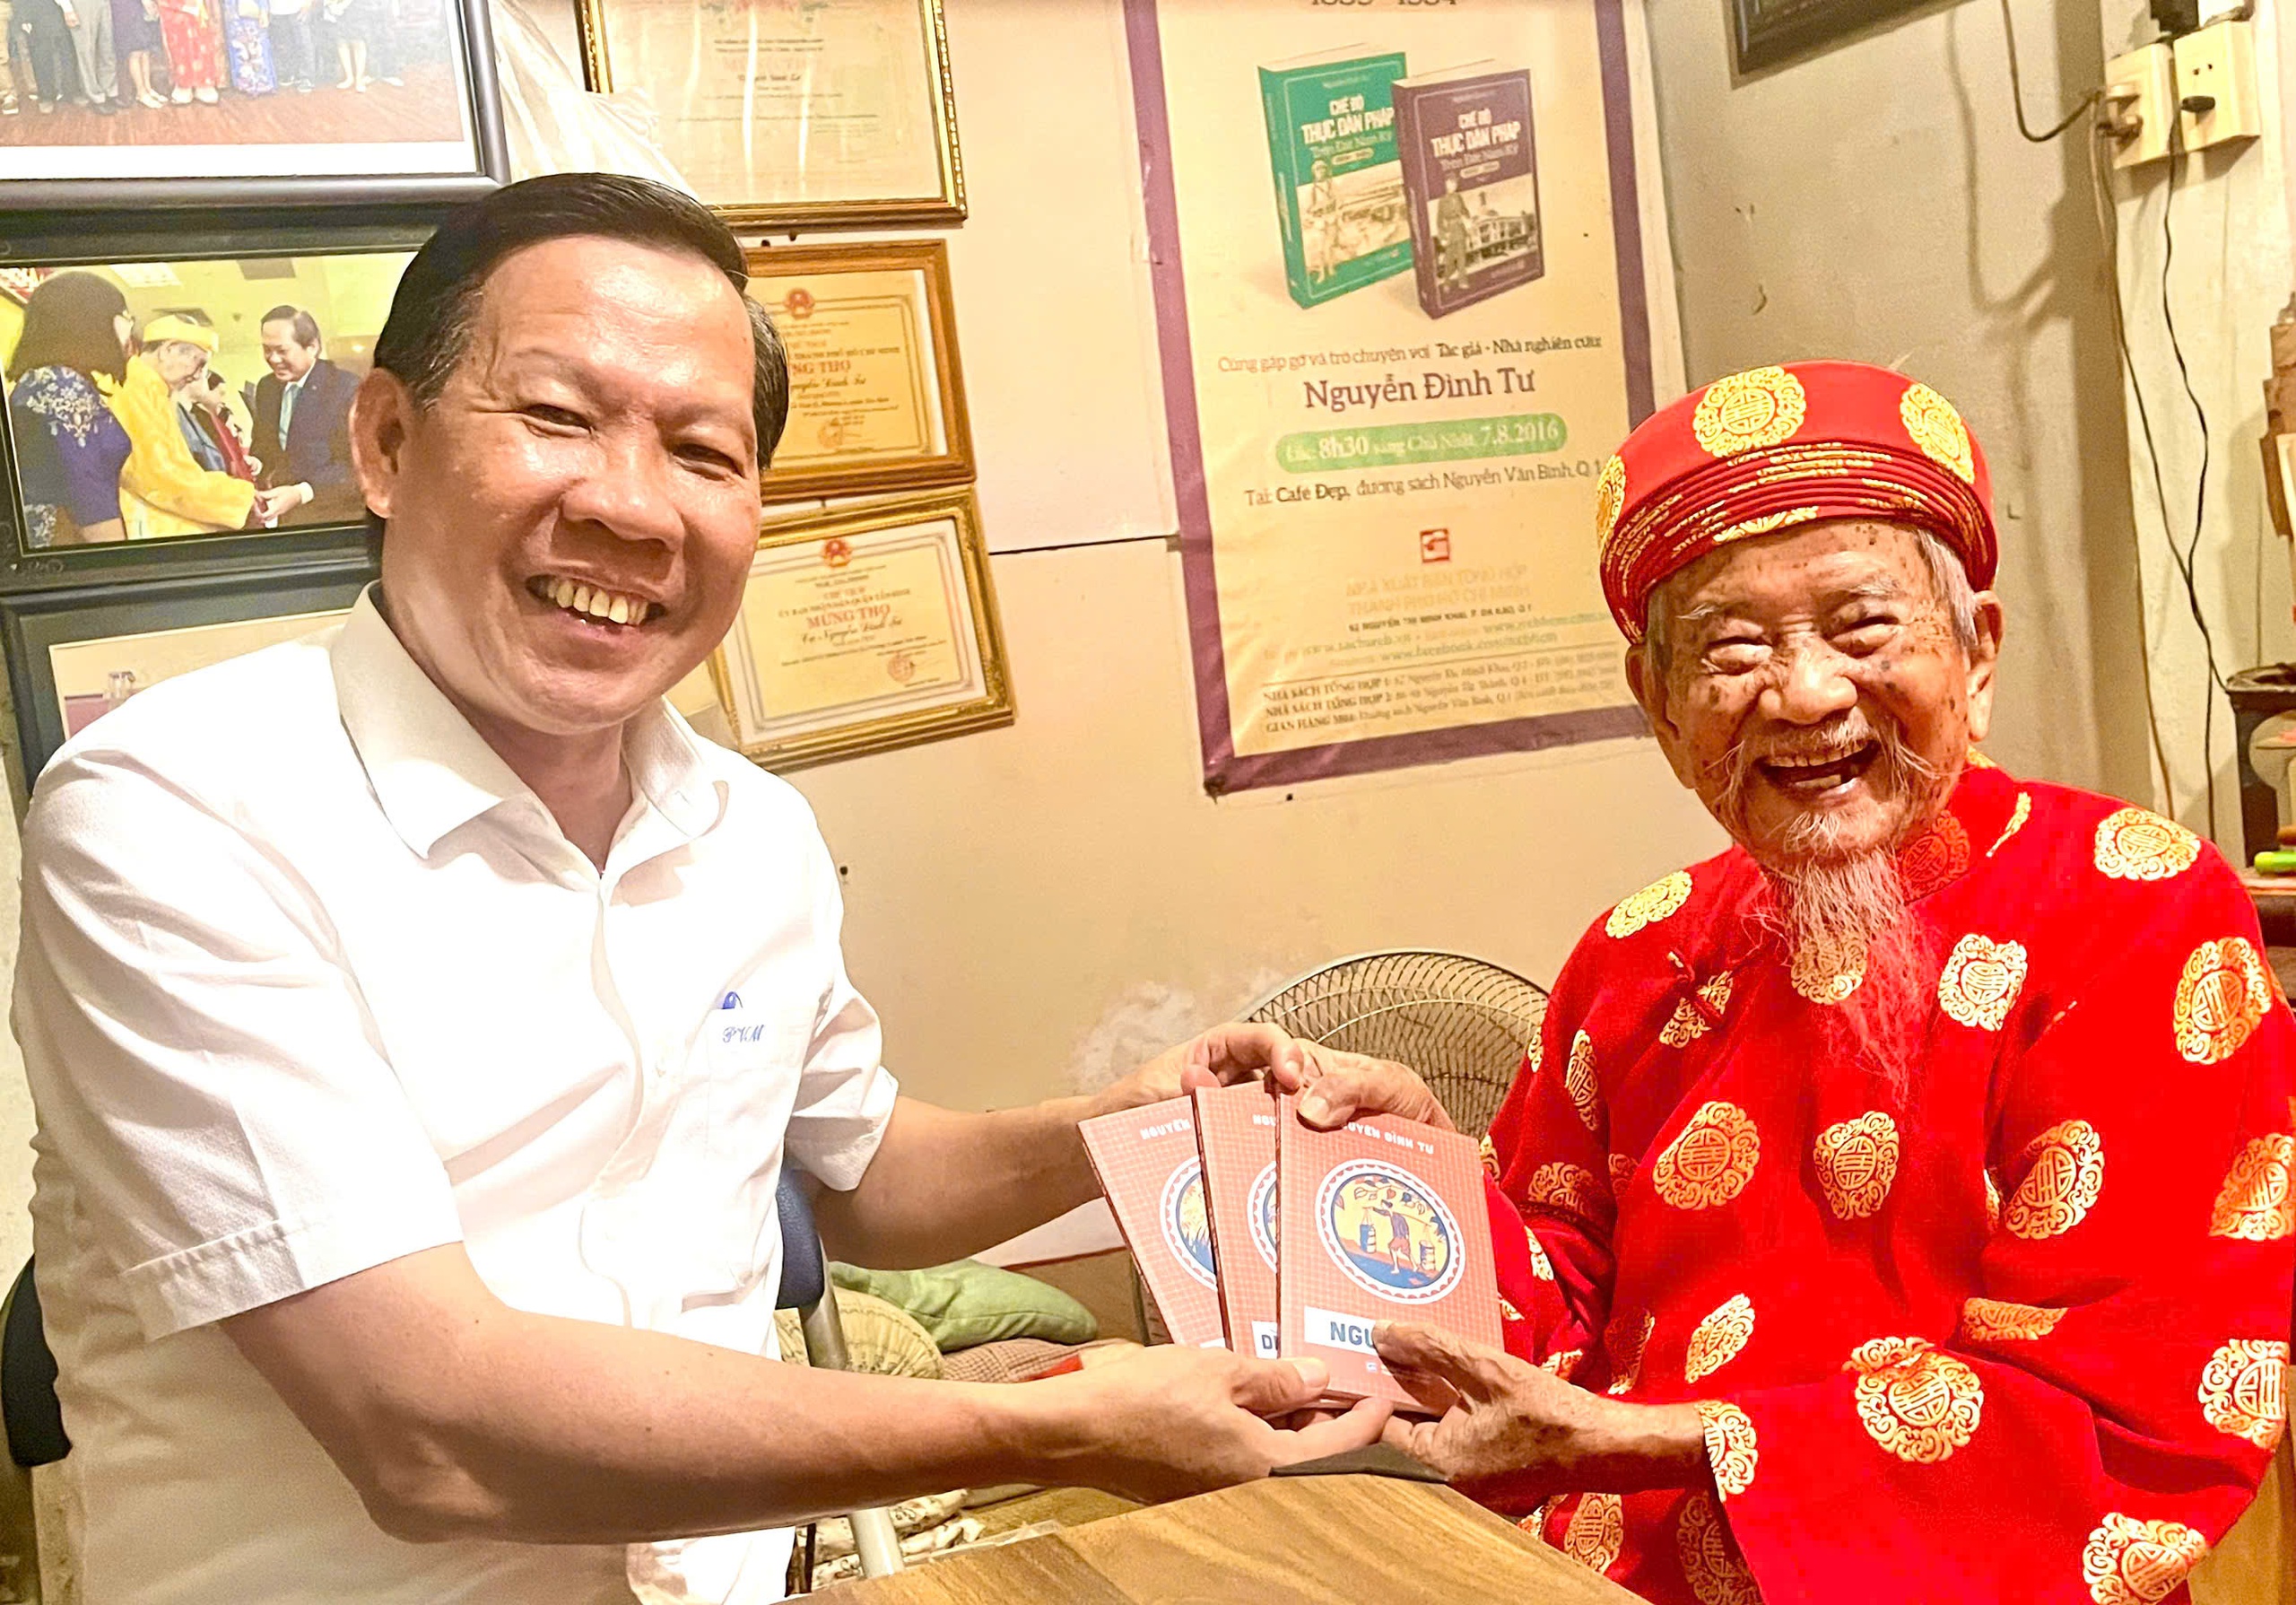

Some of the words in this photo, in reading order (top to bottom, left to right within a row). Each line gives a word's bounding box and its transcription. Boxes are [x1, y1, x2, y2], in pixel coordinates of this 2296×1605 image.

[1303, 373, 1417, 413] Nguyễn
[1423, 369, 1492, 400] Đình
[1496, 367, 1535, 394] Tư
[1318, 435, 1370, 459] 8h30
[1480, 420, 1559, 446] 7.8.2016
[1443, 467, 1501, 490] Nguyễn
